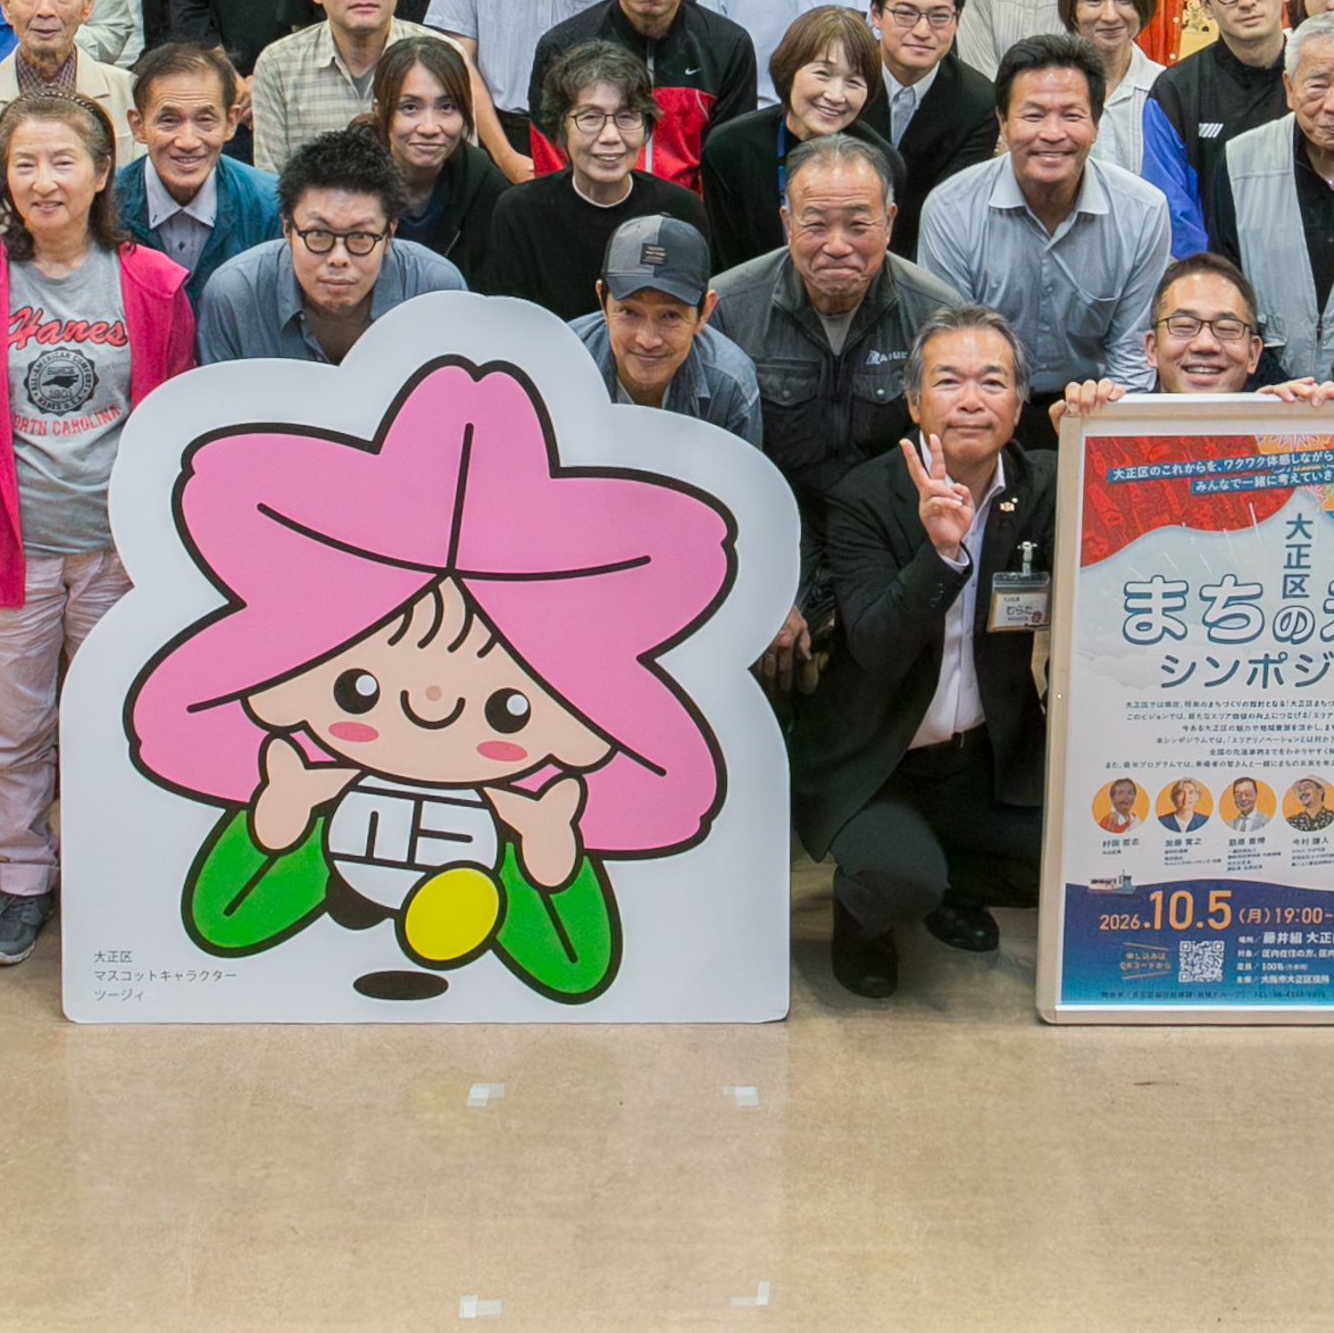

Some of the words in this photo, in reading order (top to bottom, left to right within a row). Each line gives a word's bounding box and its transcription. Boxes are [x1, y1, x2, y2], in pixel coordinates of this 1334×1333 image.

[8, 305, 128, 350] Hanes
[52, 404, 121, 436] CAROLINA
[1282, 514, 1314, 600] 大正区
[93, 950, 133, 963] 大正区
[93, 969, 237, 982] マスコットキャラクター
